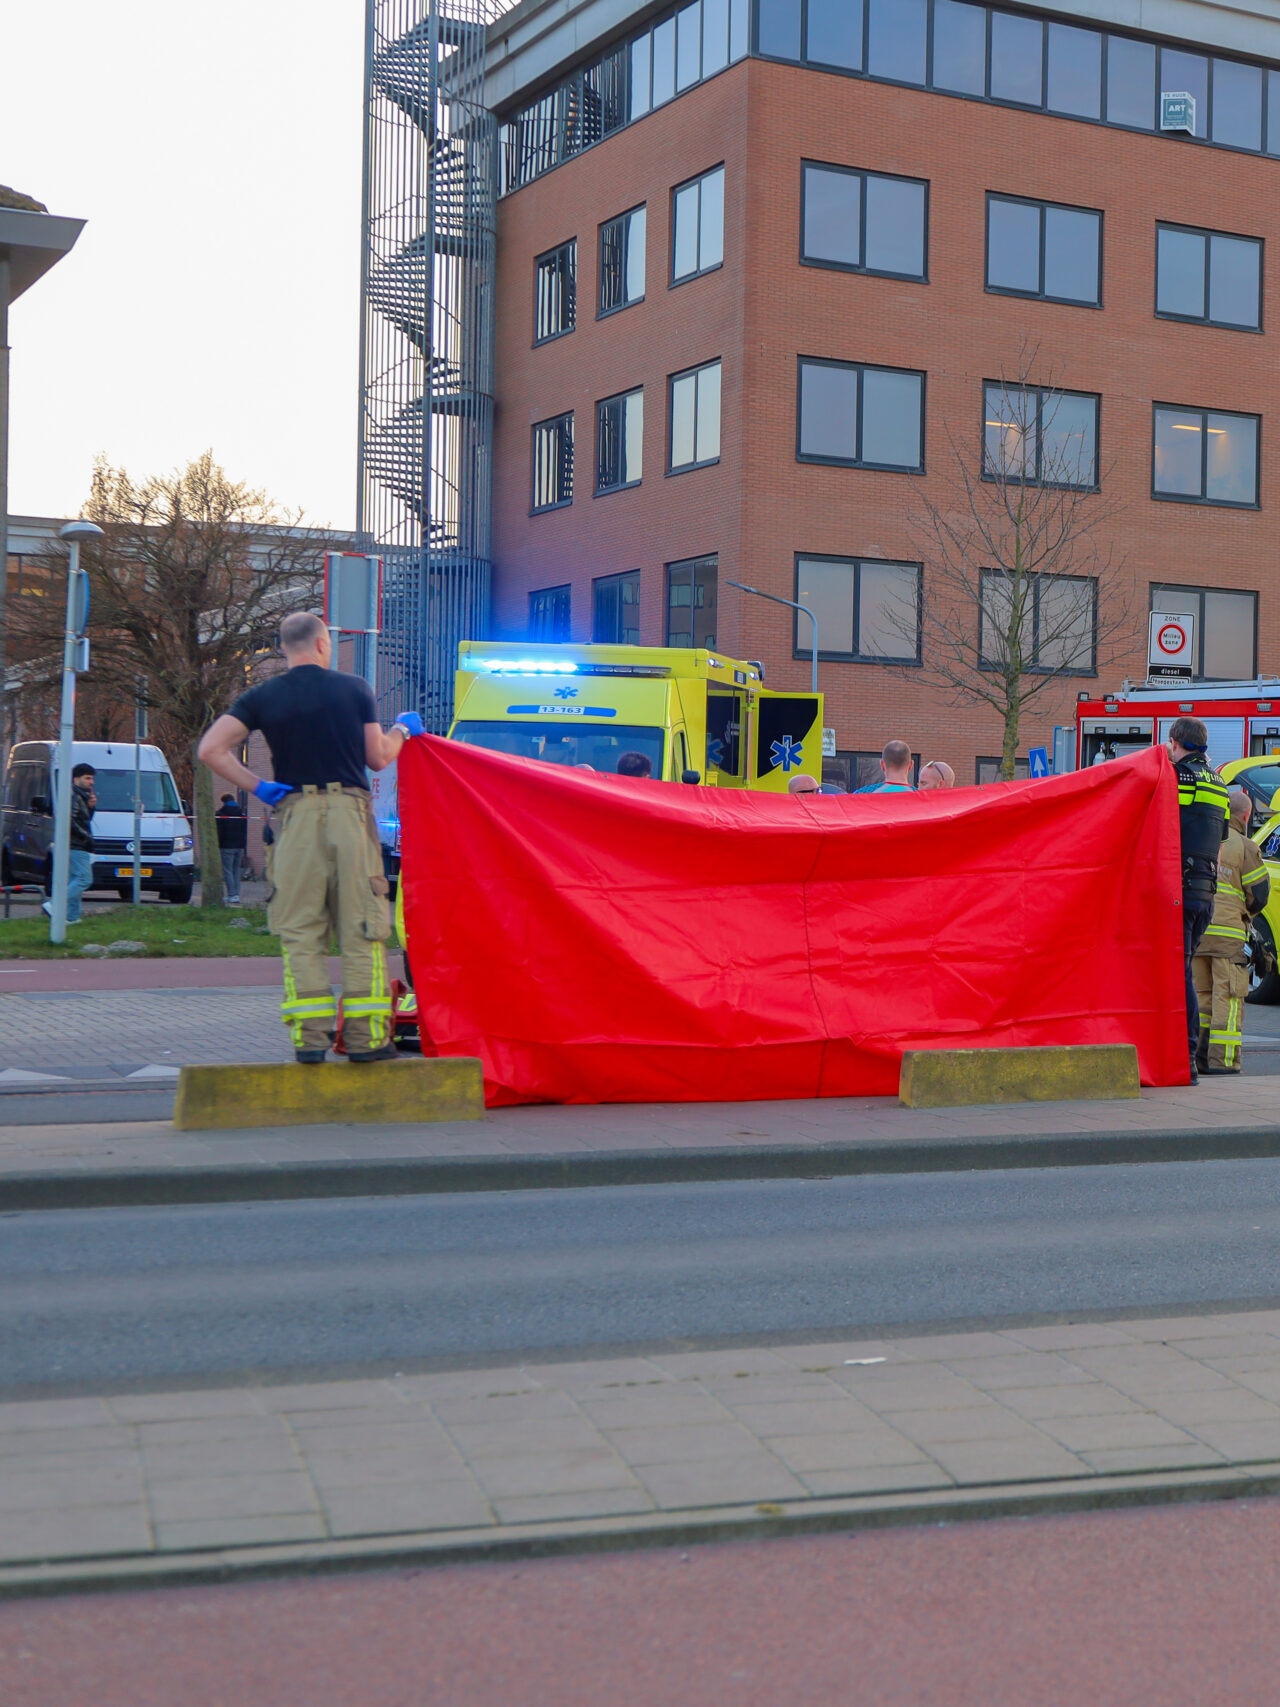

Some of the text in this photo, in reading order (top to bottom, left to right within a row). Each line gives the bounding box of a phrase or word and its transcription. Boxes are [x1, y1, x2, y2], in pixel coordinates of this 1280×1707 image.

[1168, 104, 1186, 112] ART
[1160, 668, 1180, 676] diesel
[542, 706, 582, 714] 13-163
